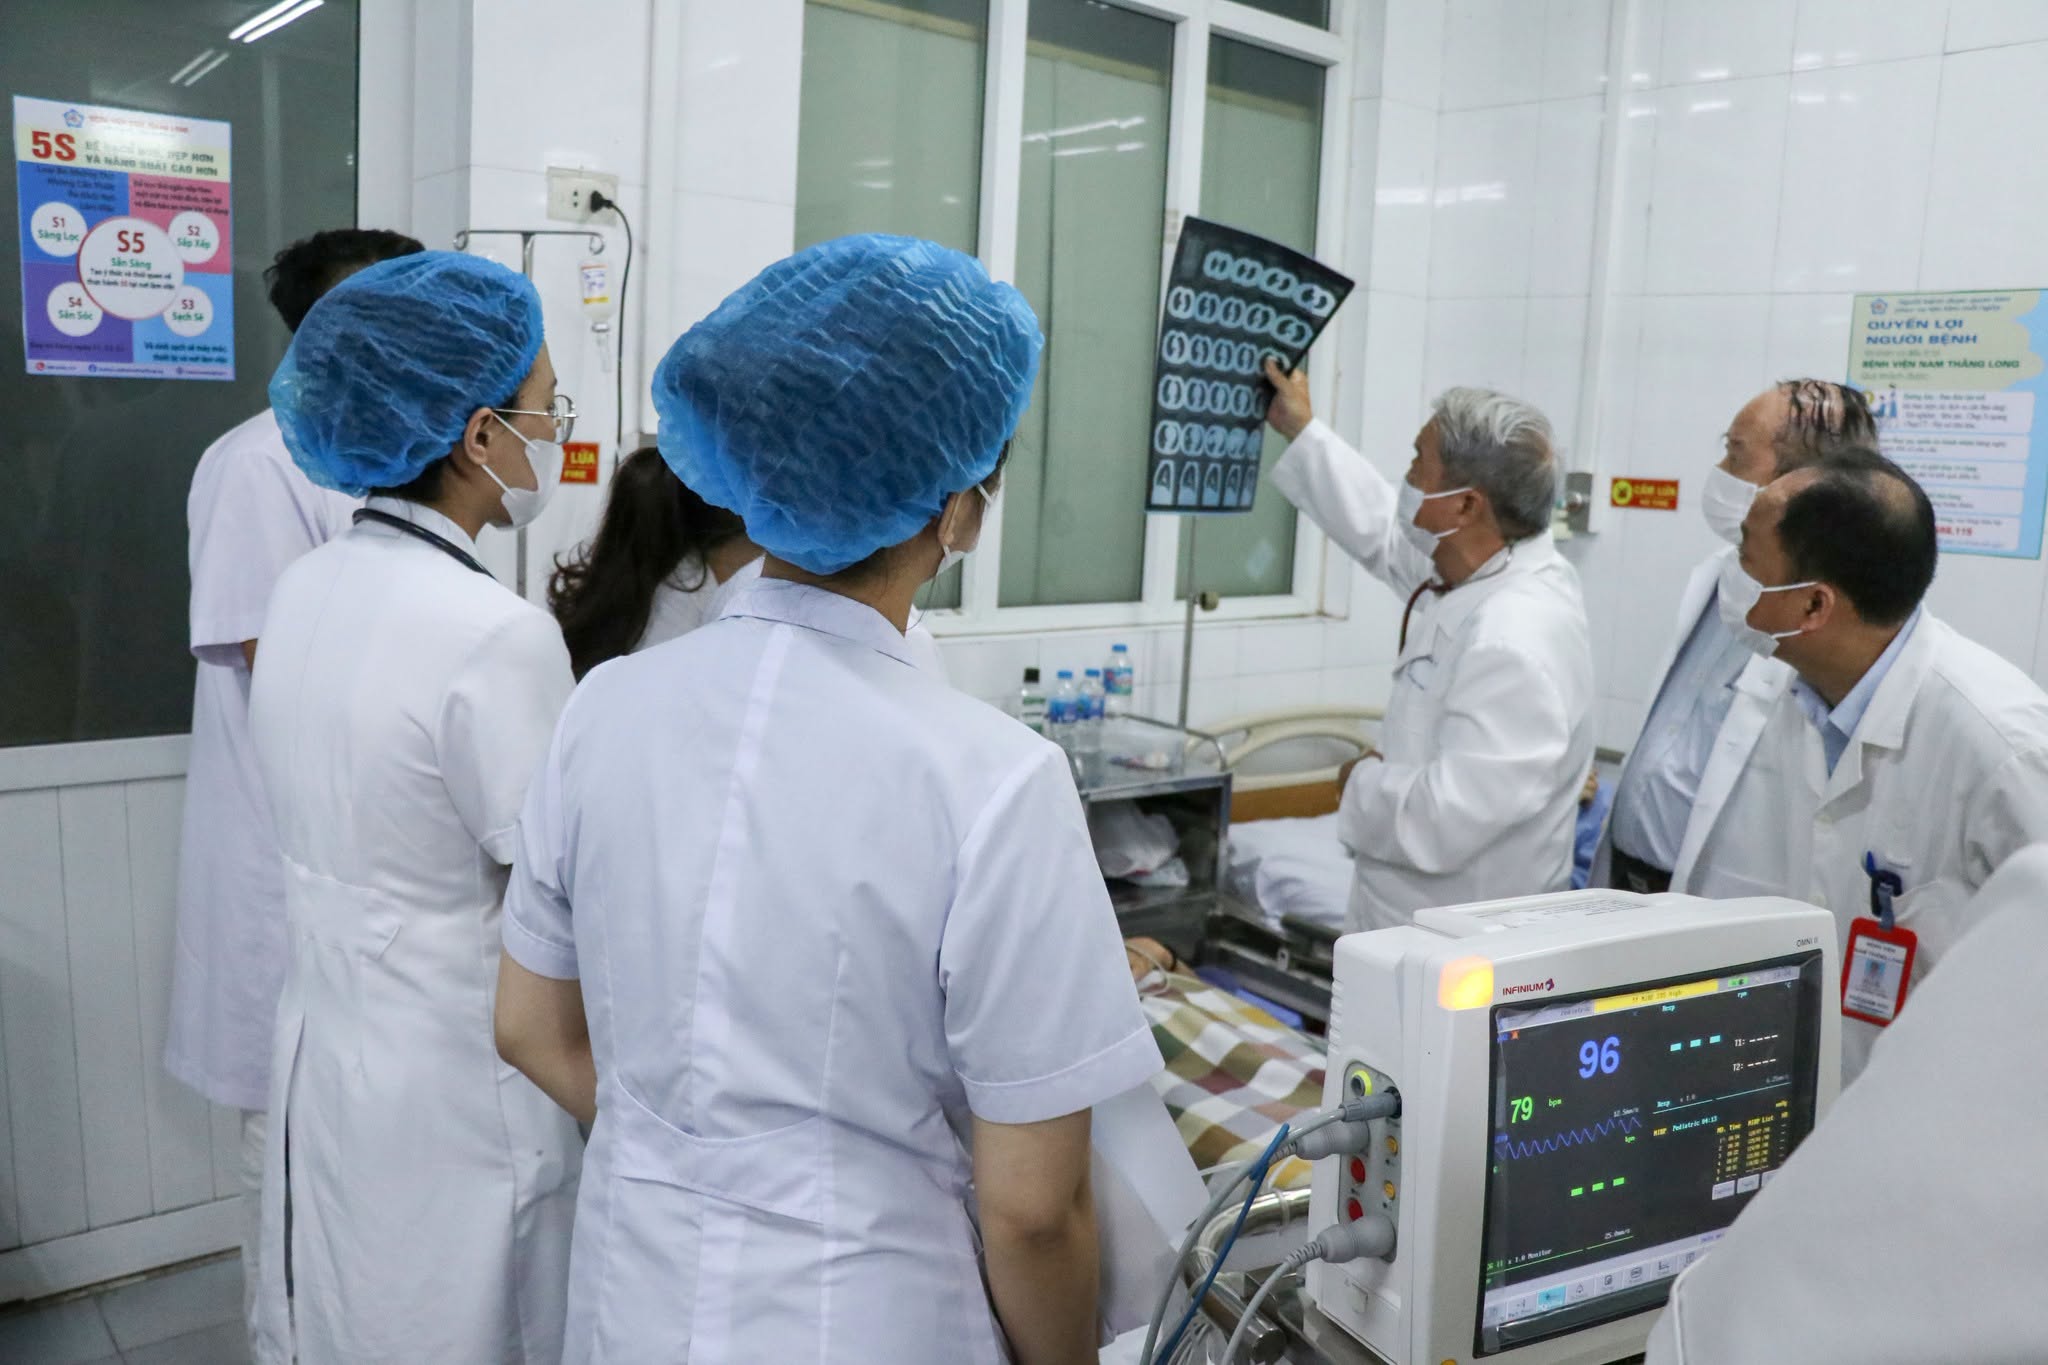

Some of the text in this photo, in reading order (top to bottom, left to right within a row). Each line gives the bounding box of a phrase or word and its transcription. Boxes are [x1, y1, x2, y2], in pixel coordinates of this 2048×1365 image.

[32, 131, 76, 161] 5S
[52, 217, 65, 228] S1
[187, 225, 200, 236] S2
[117, 230, 145, 253] S5
[68, 297, 82, 308] S4
[181, 299, 194, 310] S3
[1929, 334, 1977, 347] BỆNH
[1919, 360, 1944, 369] NAM
[1988, 360, 2020, 369] LONG
[1502, 982, 1544, 996] INFINIUM
[1578, 1035, 1621, 1079] 96
[1548, 1098, 1562, 1107] bpm
[1510, 1096, 1533, 1123] 79
[1672, 1119, 1700, 1132] Pediatric
[1528, 1248, 1552, 1259] Monitor
